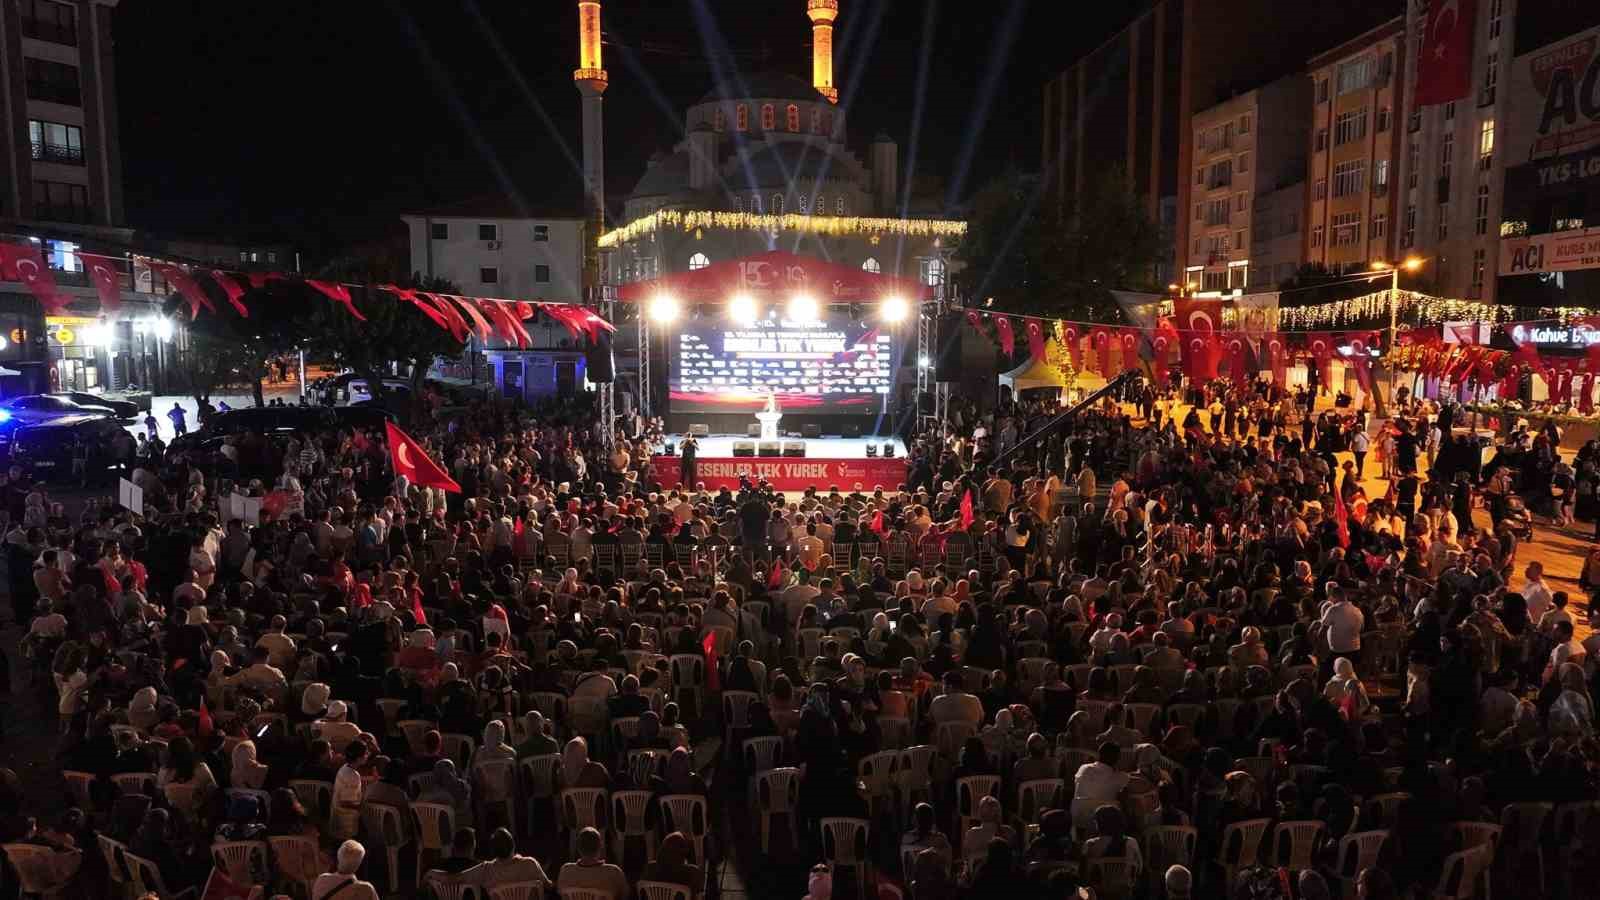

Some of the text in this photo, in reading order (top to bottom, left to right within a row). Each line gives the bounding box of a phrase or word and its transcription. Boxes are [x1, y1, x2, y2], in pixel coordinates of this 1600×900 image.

[1529, 326, 1569, 343] Kahve
[696, 463, 752, 478] ESENLER
[755, 463, 781, 478] TEK
